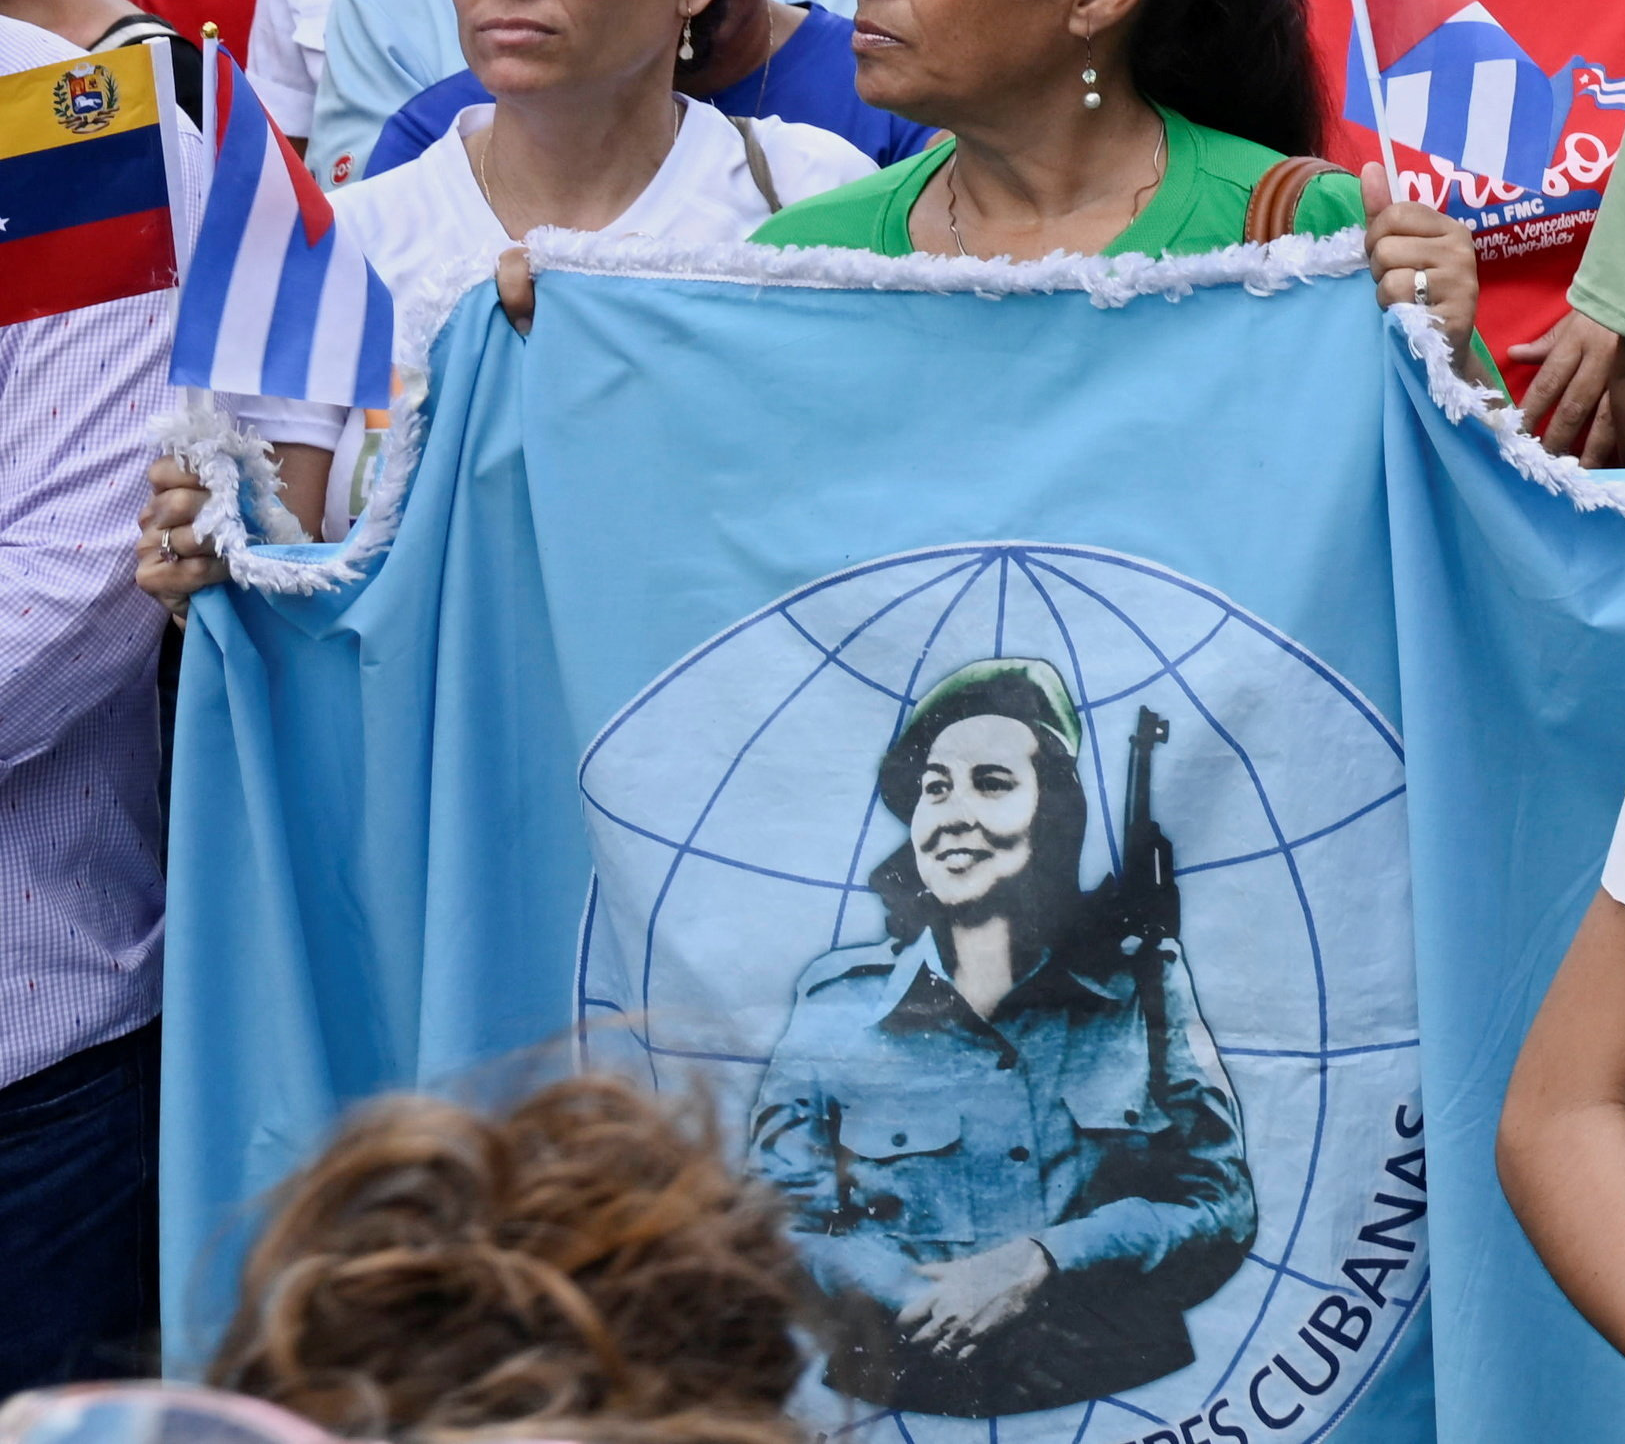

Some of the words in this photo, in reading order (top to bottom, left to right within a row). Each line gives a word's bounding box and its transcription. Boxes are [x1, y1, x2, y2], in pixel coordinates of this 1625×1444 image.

[1481, 211, 1500, 228] la
[1503, 197, 1546, 223] FMC
[1480, 249, 1499, 262] de
[1502, 230, 1575, 259] Imposibles
[1249, 1104, 1430, 1431] CUBANAS
